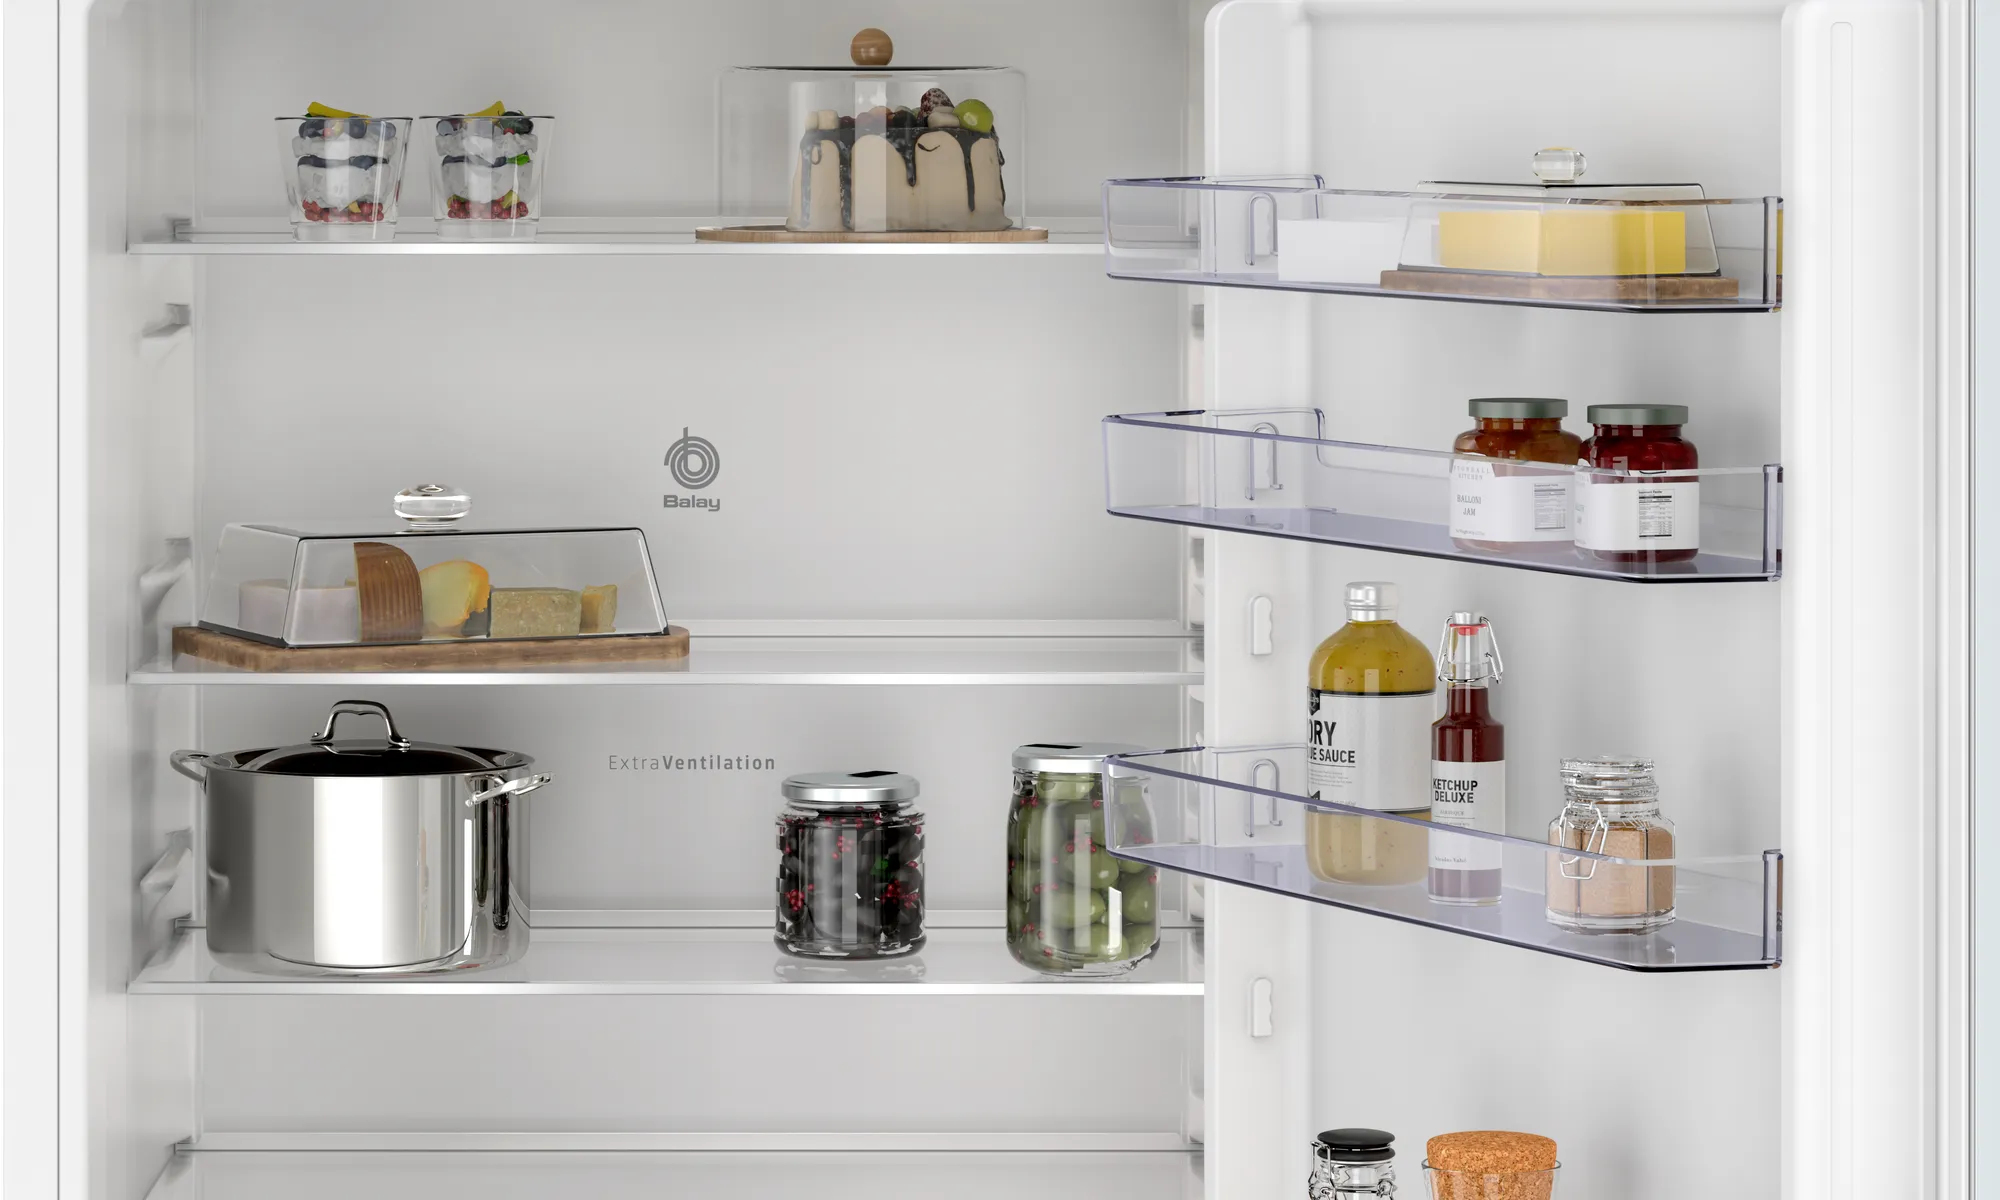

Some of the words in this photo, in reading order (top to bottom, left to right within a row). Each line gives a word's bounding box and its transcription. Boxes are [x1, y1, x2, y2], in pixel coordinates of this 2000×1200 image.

[663, 494, 721, 512] Balay
[1463, 507, 1476, 516] JAM
[609, 754, 775, 770] ExtraVentilation
[1319, 748, 1356, 763] SAUCE
[1433, 778, 1478, 792] KETCHUP
[1435, 791, 1474, 804] DELUXE
